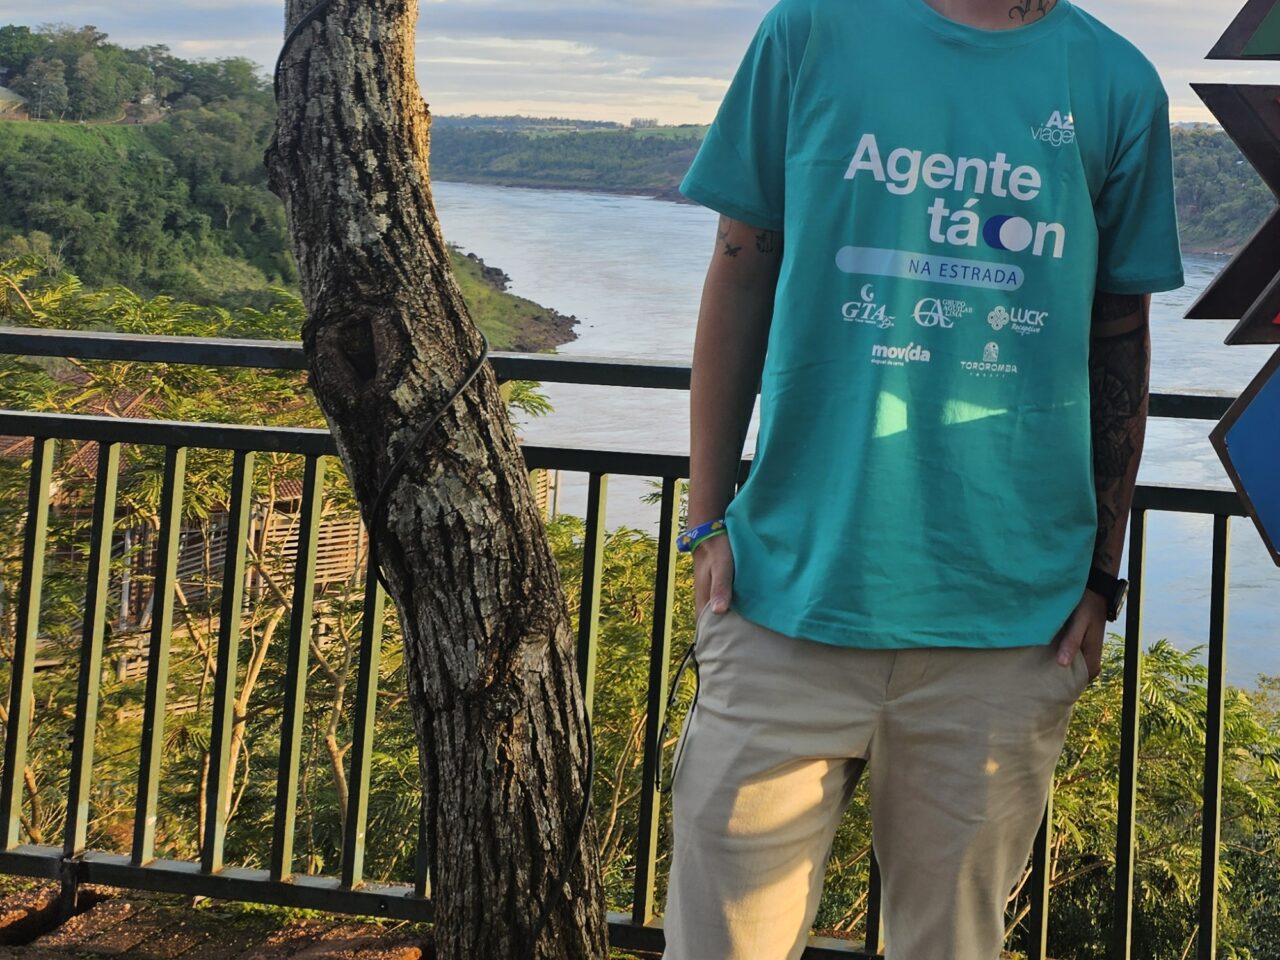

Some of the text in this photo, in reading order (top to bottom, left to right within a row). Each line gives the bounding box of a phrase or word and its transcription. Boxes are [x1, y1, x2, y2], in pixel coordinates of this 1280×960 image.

[844, 133, 1041, 201] Agente
[928, 197, 980, 247] tá
[909, 259, 1017, 285] NA ESTRADA
[1010, 307, 1048, 326] LUCK
[872, 342, 930, 362] movida
[960, 361, 1018, 373] TOROROMBA
